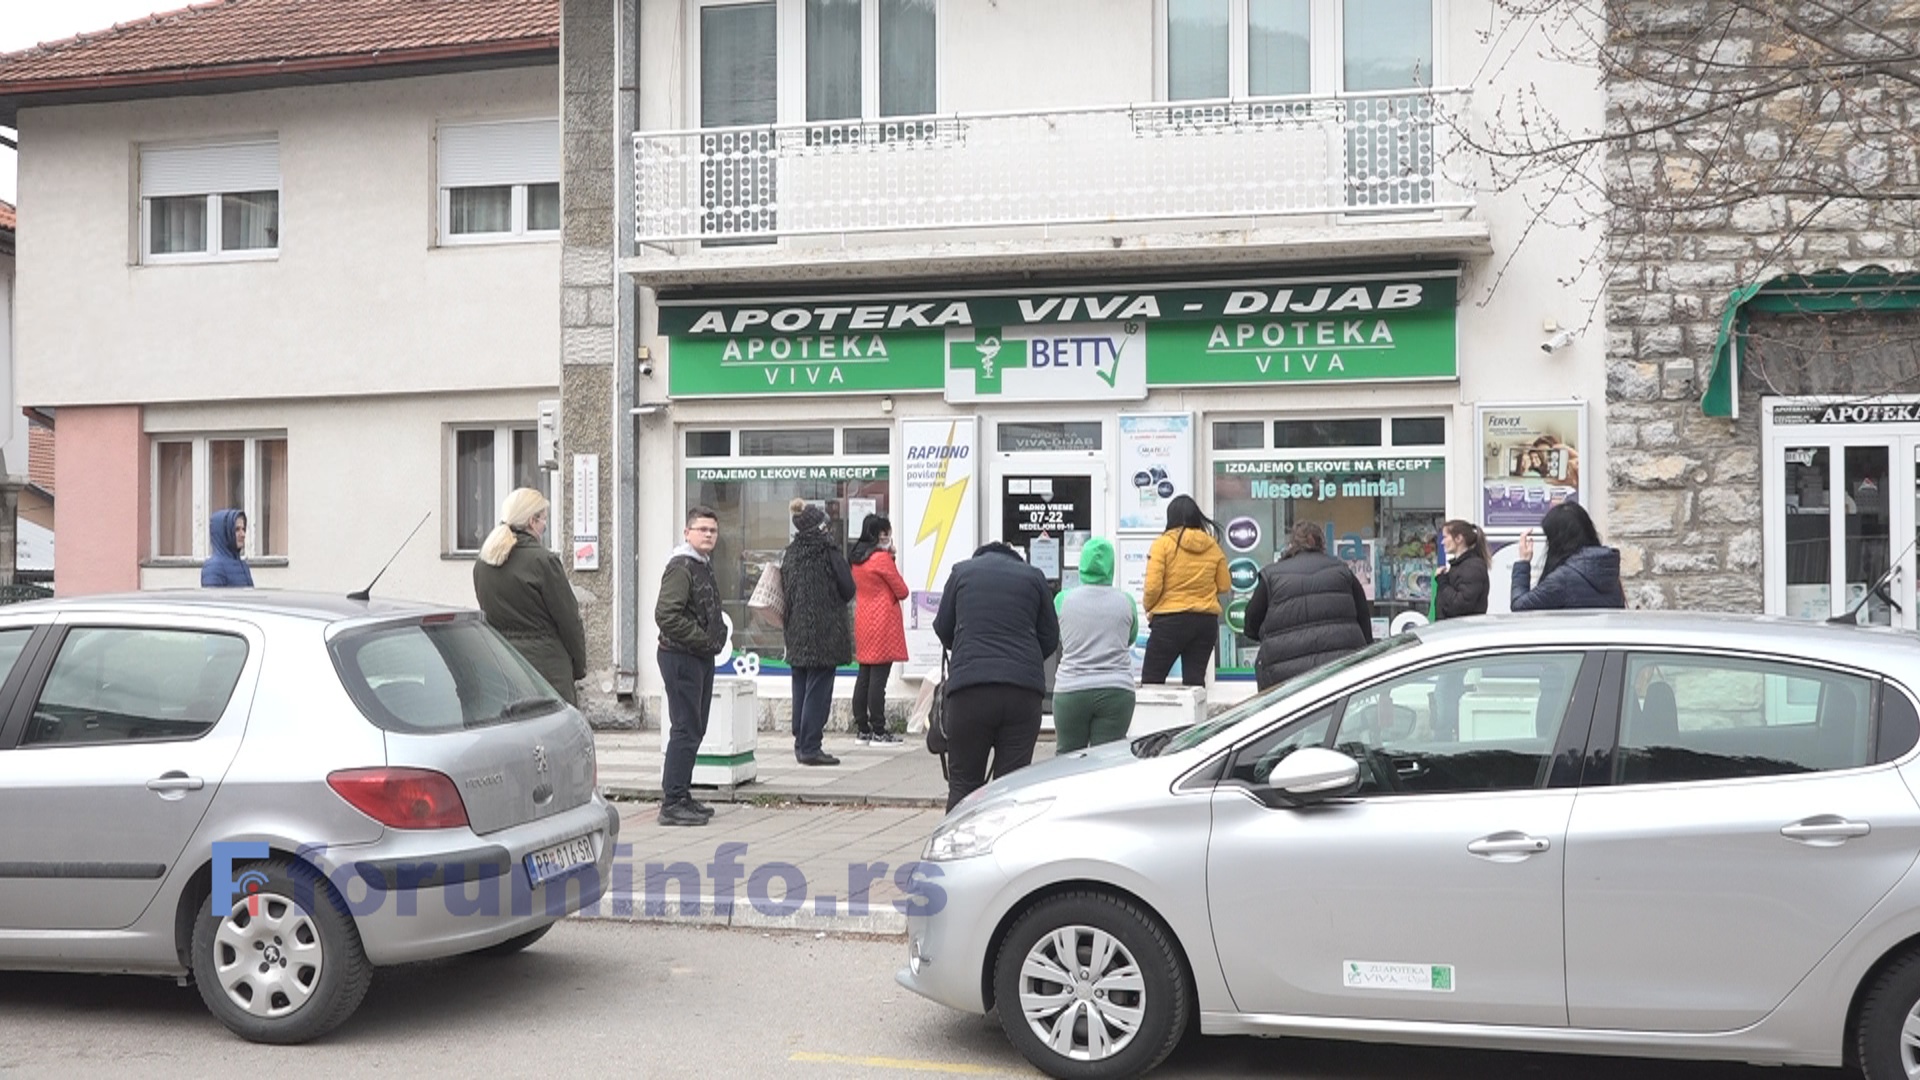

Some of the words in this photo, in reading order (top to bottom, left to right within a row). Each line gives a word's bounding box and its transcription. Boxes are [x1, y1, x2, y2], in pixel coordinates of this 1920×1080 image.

[689, 302, 973, 334] APOTEKA
[1018, 295, 1161, 322] VIVA
[1183, 303, 1203, 312] -
[1223, 283, 1423, 315] DIJAB
[1208, 320, 1394, 348] APOTEKA
[721, 335, 888, 362] APOTEKA
[1255, 353, 1345, 373] VIVA
[765, 366, 844, 385] VIVA
[907, 445, 970, 460] RAPIDNO
[697, 468, 758, 480] IZDAJEMO
[760, 467, 806, 479] LEKOVE
[810, 467, 827, 479] NA
[829, 467, 878, 478] RECEPT
[1225, 462, 1294, 474] IZDAJEMO
[1298, 461, 1350, 473] LEKOVE
[1354, 460, 1374, 472] NA
[1377, 459, 1432, 471] RECEPT
[1251, 480, 1314, 499] Mesec
[1317, 479, 1337, 501] je
[1342, 478, 1405, 497] minta!
[1019, 503, 1046, 511] RADNO
[1047, 503, 1074, 511] VREME
[1030, 511, 1063, 523] 07-22
[1019, 523, 1056, 531] NEDELJOM
[535, 853, 550, 877] PP
